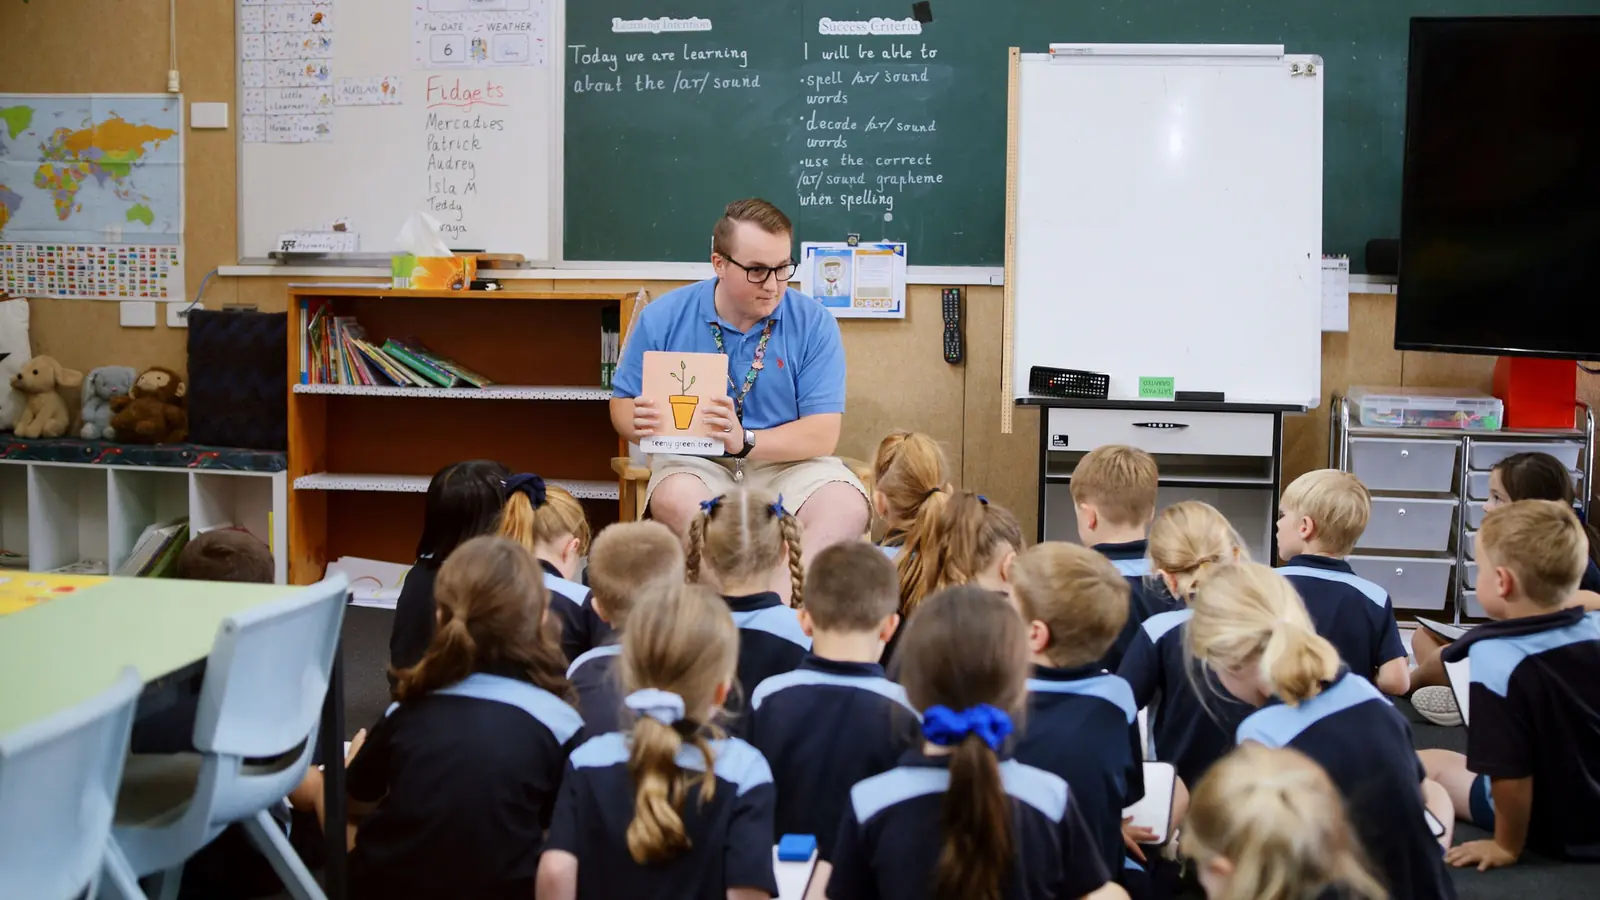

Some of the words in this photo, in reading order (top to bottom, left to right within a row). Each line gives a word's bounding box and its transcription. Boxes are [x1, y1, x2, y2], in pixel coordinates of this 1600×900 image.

[440, 22, 464, 31] DATE
[486, 22, 532, 31] WEATHER
[615, 20, 660, 32] Learning
[663, 19, 710, 30] Intention
[822, 21, 867, 32] Success
[870, 20, 919, 32] Criteria
[444, 44, 453, 56] 6
[568, 44, 618, 72] Today
[626, 52, 645, 62] we
[652, 52, 676, 61] are
[683, 43, 748, 68] learning
[822, 44, 850, 60] will
[858, 44, 876, 58] be
[882, 43, 912, 59] able
[920, 43, 938, 59] to
[278, 68, 296, 80] Play
[574, 74, 622, 93] about
[634, 74, 666, 92] the
[672, 70, 710, 94] /ar/
[713, 74, 761, 89] sound
[851, 71, 880, 86] /ar/
[884, 66, 930, 83] sound
[280, 92, 303, 100] Little
[342, 86, 379, 94] AUSLAN
[426, 74, 504, 113] Fidgets
[806, 90, 848, 104] words
[269, 124, 291, 132] Home
[294, 122, 314, 131] Time
[425, 112, 504, 131] Mercadies
[806, 109, 857, 131] decode
[864, 116, 895, 132] /ar/
[896, 120, 937, 132] sound
[427, 133, 482, 152] Patrick
[806, 134, 848, 148] words
[427, 152, 476, 180] Audrey
[804, 158, 829, 168] use
[840, 153, 864, 166] the
[876, 153, 932, 166] correct
[428, 174, 457, 195] Isla
[463, 182, 478, 195] M
[796, 170, 824, 190] /ar/
[826, 172, 866, 185] sound
[876, 170, 944, 193] grapheme
[800, 192, 834, 206] when
[840, 188, 894, 212] spelling
[426, 196, 463, 222] Teddy
[652, 440, 672, 449] teeny
[674, 441, 696, 450] green
